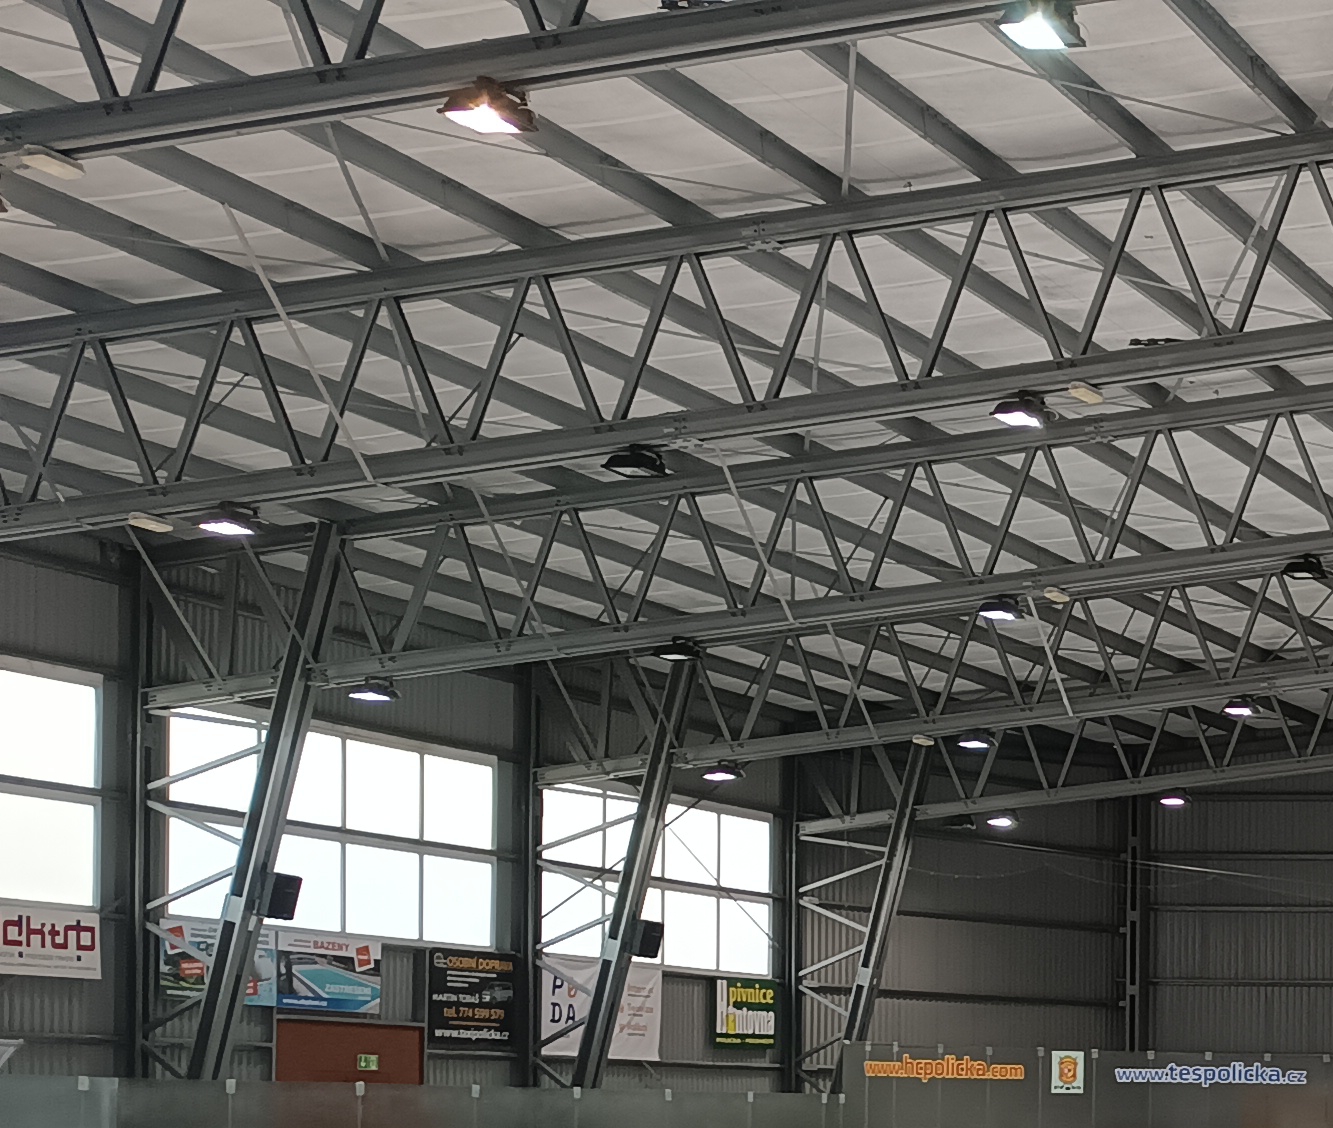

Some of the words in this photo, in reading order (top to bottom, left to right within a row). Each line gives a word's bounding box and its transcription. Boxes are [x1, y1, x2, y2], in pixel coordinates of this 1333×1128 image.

[729, 982, 774, 1006] pivnice
[864, 1054, 1025, 1082] www.hcpolicka.com
[1115, 1062, 1307, 1087] www.tespolicka.cz
